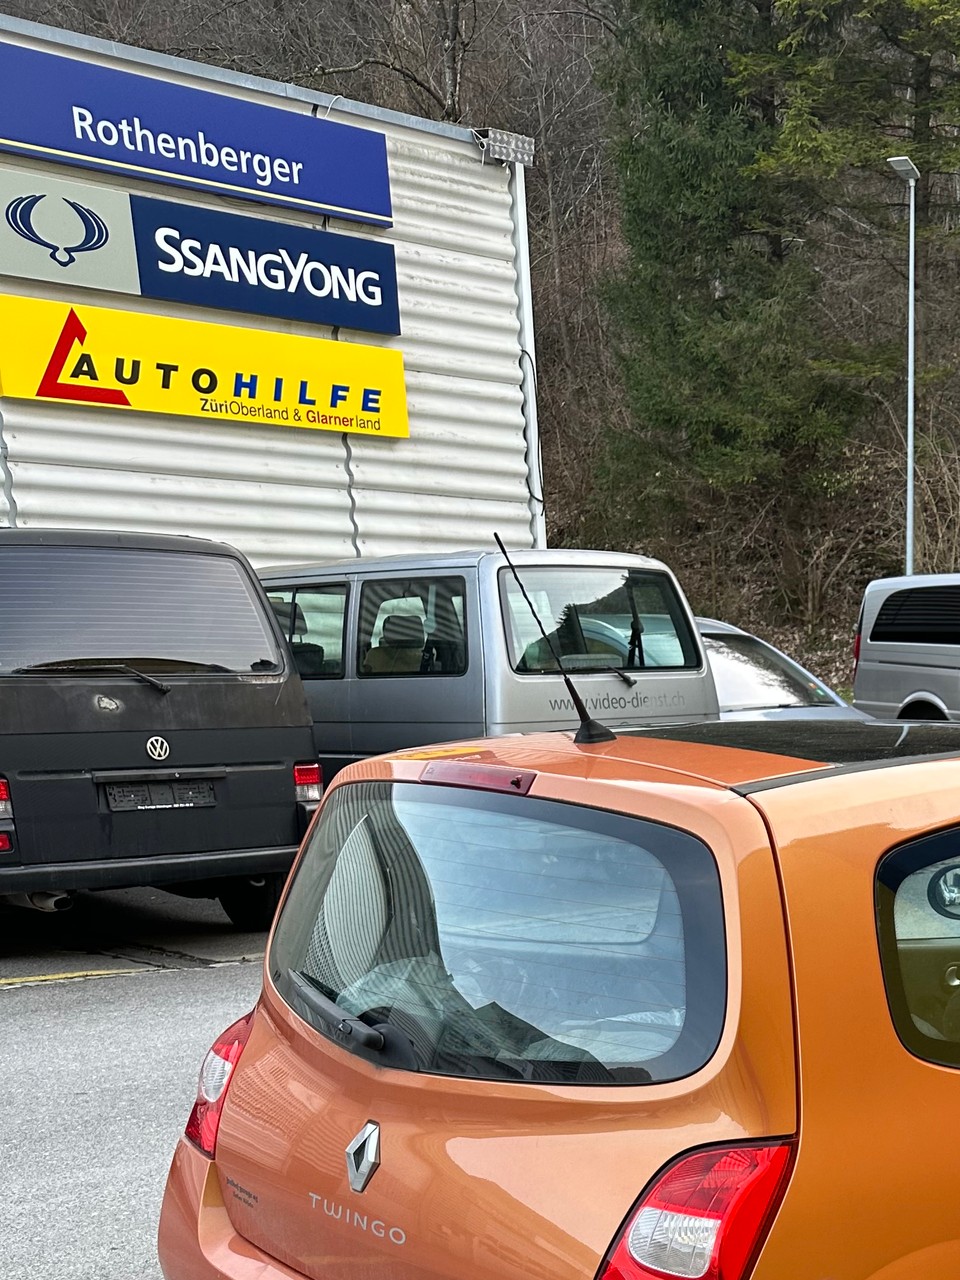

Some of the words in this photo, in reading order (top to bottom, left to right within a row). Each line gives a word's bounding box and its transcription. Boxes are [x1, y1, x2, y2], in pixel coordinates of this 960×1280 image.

[72, 105, 303, 187] Rothenberger
[154, 226, 383, 306] SSANGYONG
[69, 352, 382, 413] AUTOHILFE
[200, 398, 289, 421] ZüriOberland
[293, 408, 302, 422] &
[306, 409, 381, 431] Glarnerland
[308, 1192, 407, 1245] TWINGO
